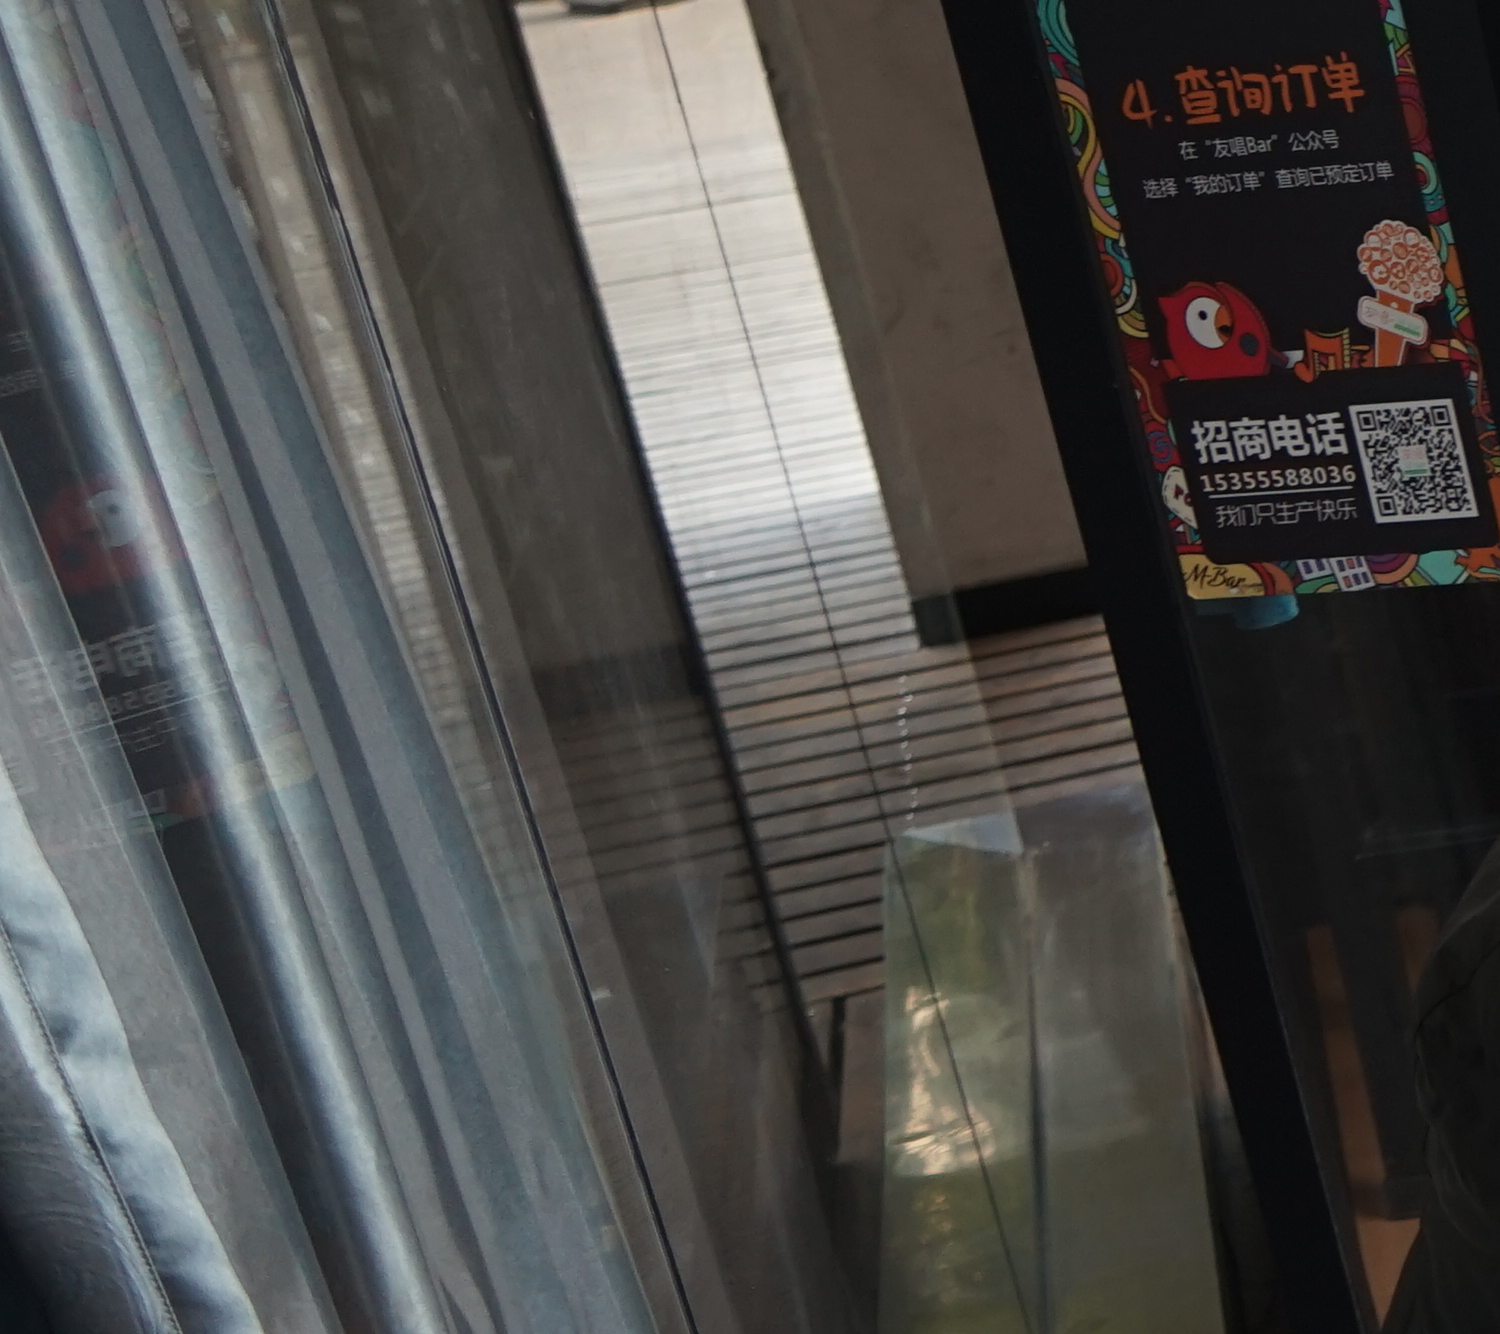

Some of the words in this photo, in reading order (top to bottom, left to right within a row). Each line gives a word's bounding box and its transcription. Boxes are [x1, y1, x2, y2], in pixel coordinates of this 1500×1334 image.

[1121, 51, 1366, 126] 4.查询订单
[1191, 410, 1349, 466] 招商电话
[1199, 464, 1357, 494] 15355588036
[1215, 497, 1359, 532] 我们只生产快乐
